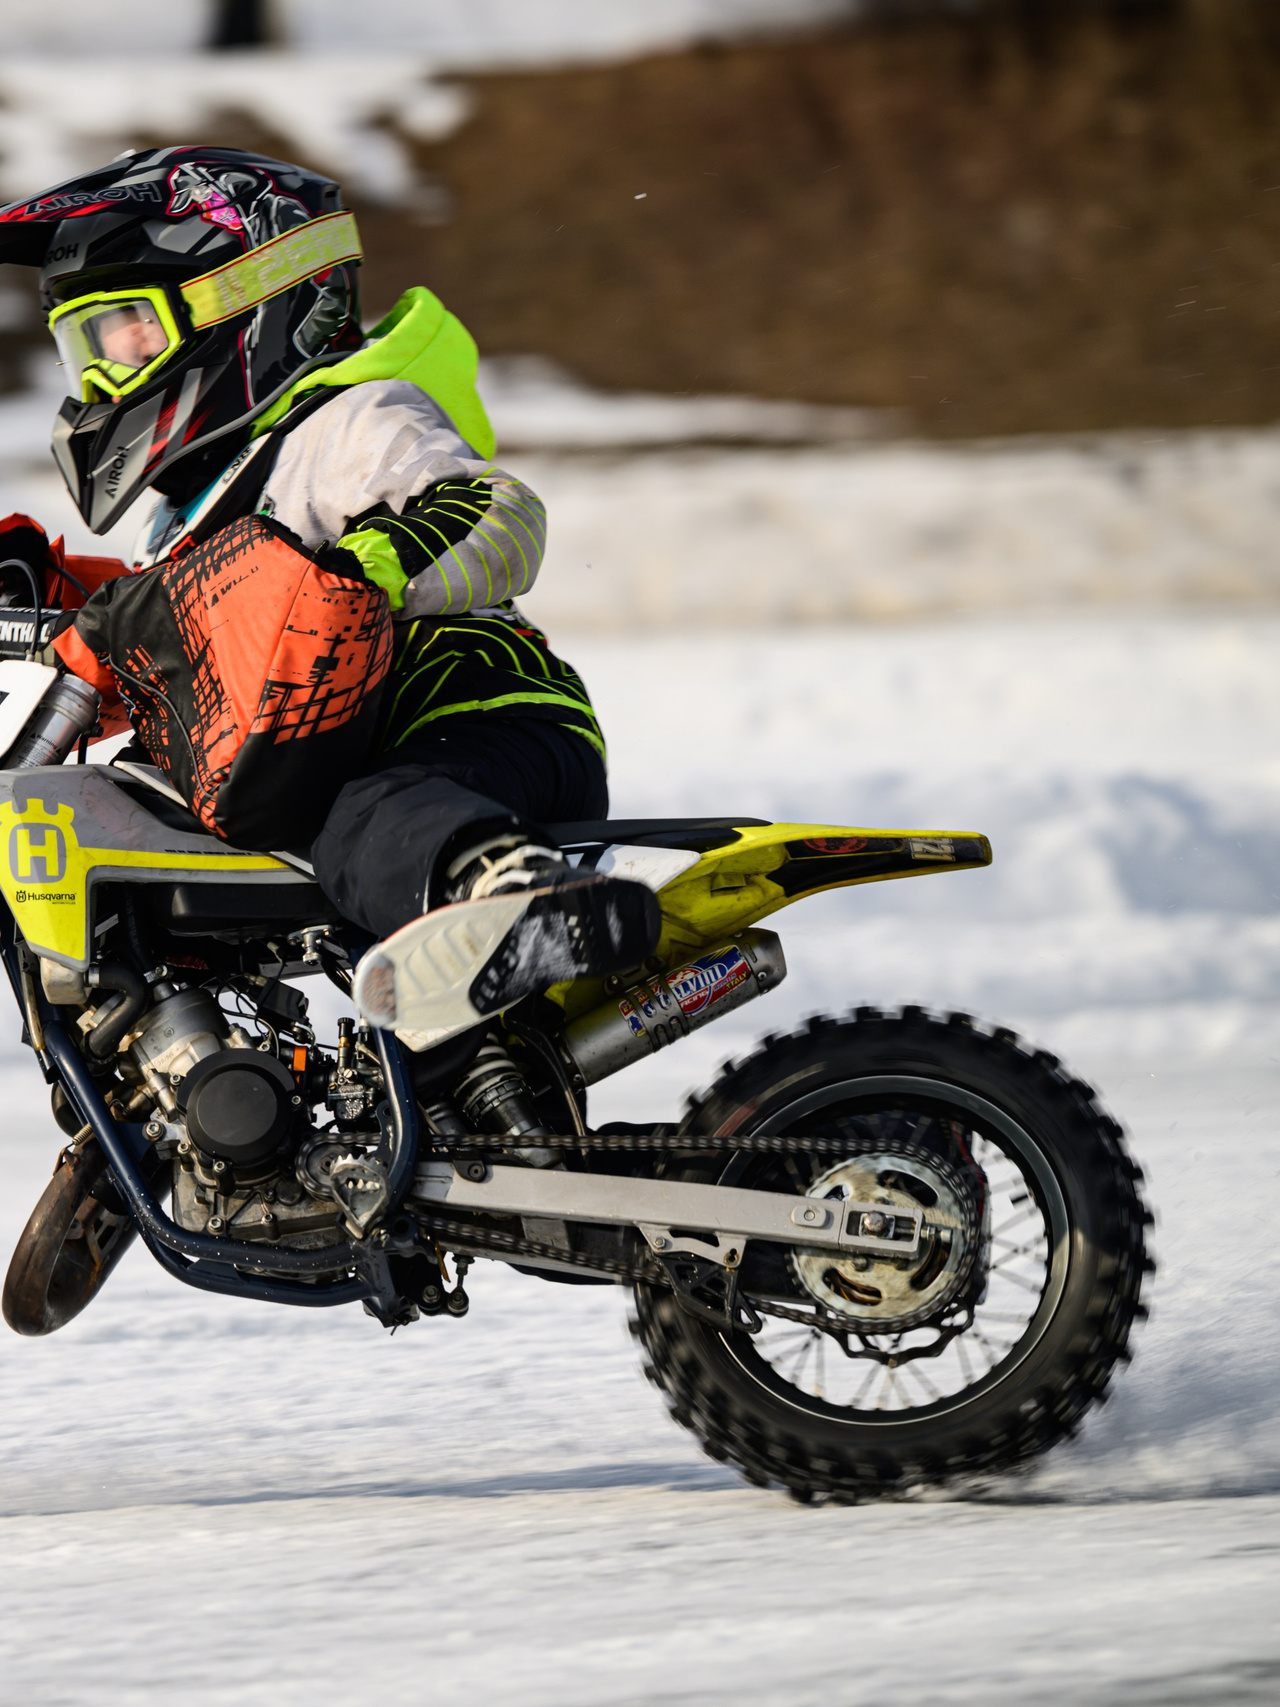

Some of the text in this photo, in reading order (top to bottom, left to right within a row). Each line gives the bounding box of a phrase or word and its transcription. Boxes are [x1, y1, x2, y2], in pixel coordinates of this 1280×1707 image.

[23, 181, 162, 216] AIROH
[46, 242, 79, 264] ROH
[105, 446, 129, 499] AIROH
[28, 892, 76, 902] Husqvarna
